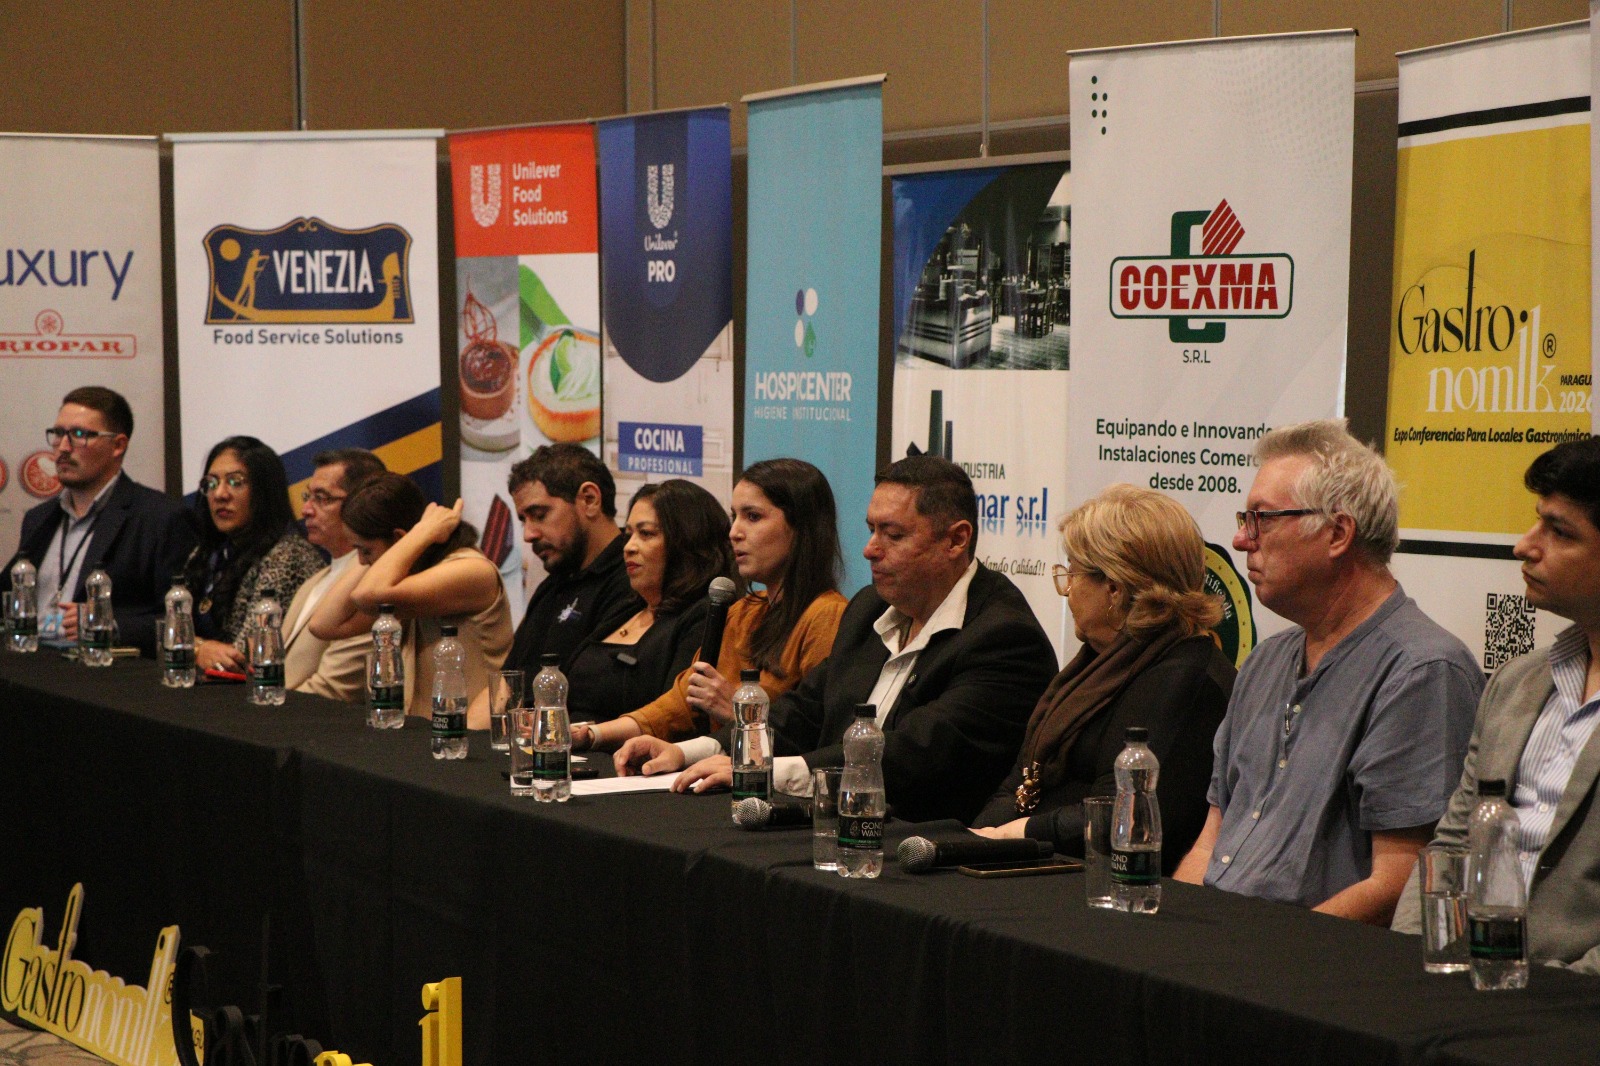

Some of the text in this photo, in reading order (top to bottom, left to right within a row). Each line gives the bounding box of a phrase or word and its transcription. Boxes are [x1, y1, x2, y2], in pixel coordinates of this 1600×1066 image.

[512, 161, 561, 181] Unilever
[512, 185, 542, 203] Food
[513, 208, 568, 226] Solutions
[273, 248, 375, 296] VENEZIA
[648, 260, 676, 282] PRO
[1119, 263, 1279, 311] COEXMA
[1397, 248, 1515, 355] Gastro
[213, 328, 404, 345] Food Service Solutions
[1182, 350, 1211, 364] S.R.L
[754, 371, 852, 402] HOSPICENTER
[1559, 374, 1593, 387] PARAGU
[754, 406, 852, 421] HIGIENE INSTITUCIONAL
[1096, 418, 1177, 440] Equipando
[1181, 424, 1190, 438] e
[1409, 426, 1465, 446] Conferencias
[1466, 427, 1487, 443] Para
[1488, 427, 1524, 443] Locales
[634, 427, 685, 453] COCINA
[1099, 444, 1196, 465] Instalaciones
[628, 456, 693, 475] PROFESIONAL
[1149, 472, 1242, 494] desde 2008.
